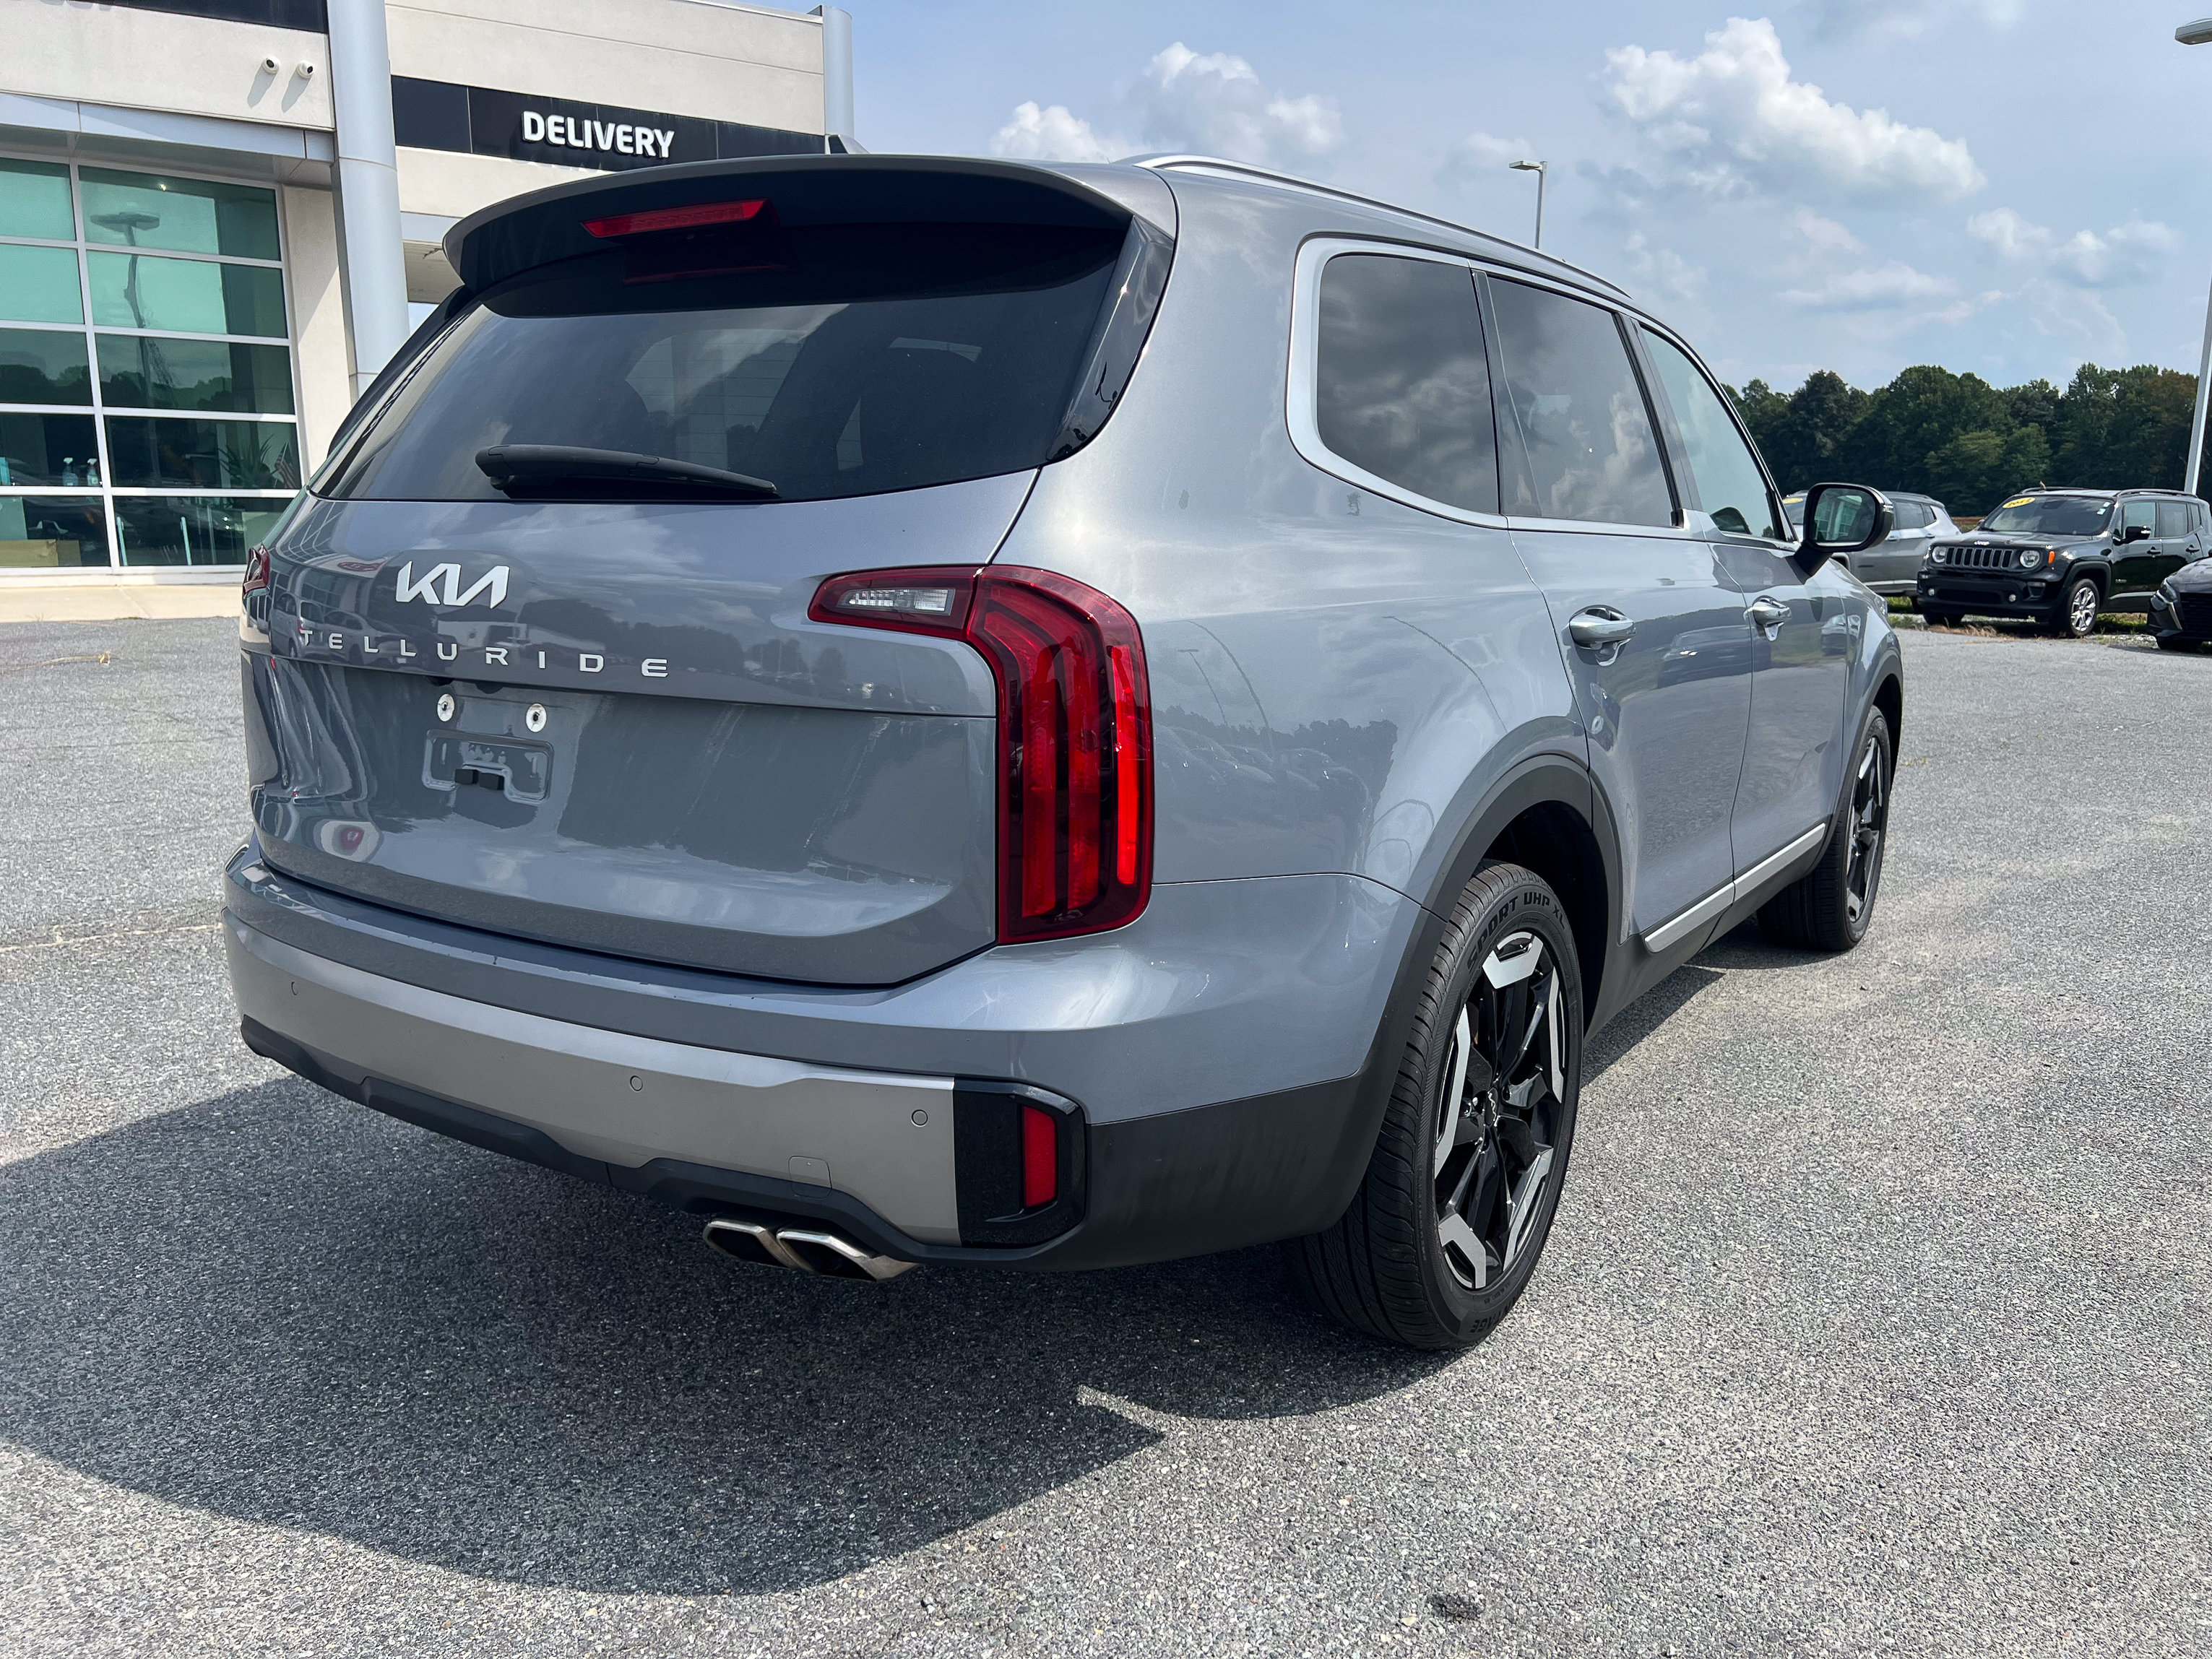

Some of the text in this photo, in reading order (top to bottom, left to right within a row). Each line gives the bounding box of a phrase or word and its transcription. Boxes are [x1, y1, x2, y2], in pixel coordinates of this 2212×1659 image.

[522, 111, 675, 159] DELIVERY
[300, 629, 669, 677] TELLURIDE
[1467, 896, 1518, 974] SPORT
[1524, 891, 1550, 907] UHP
